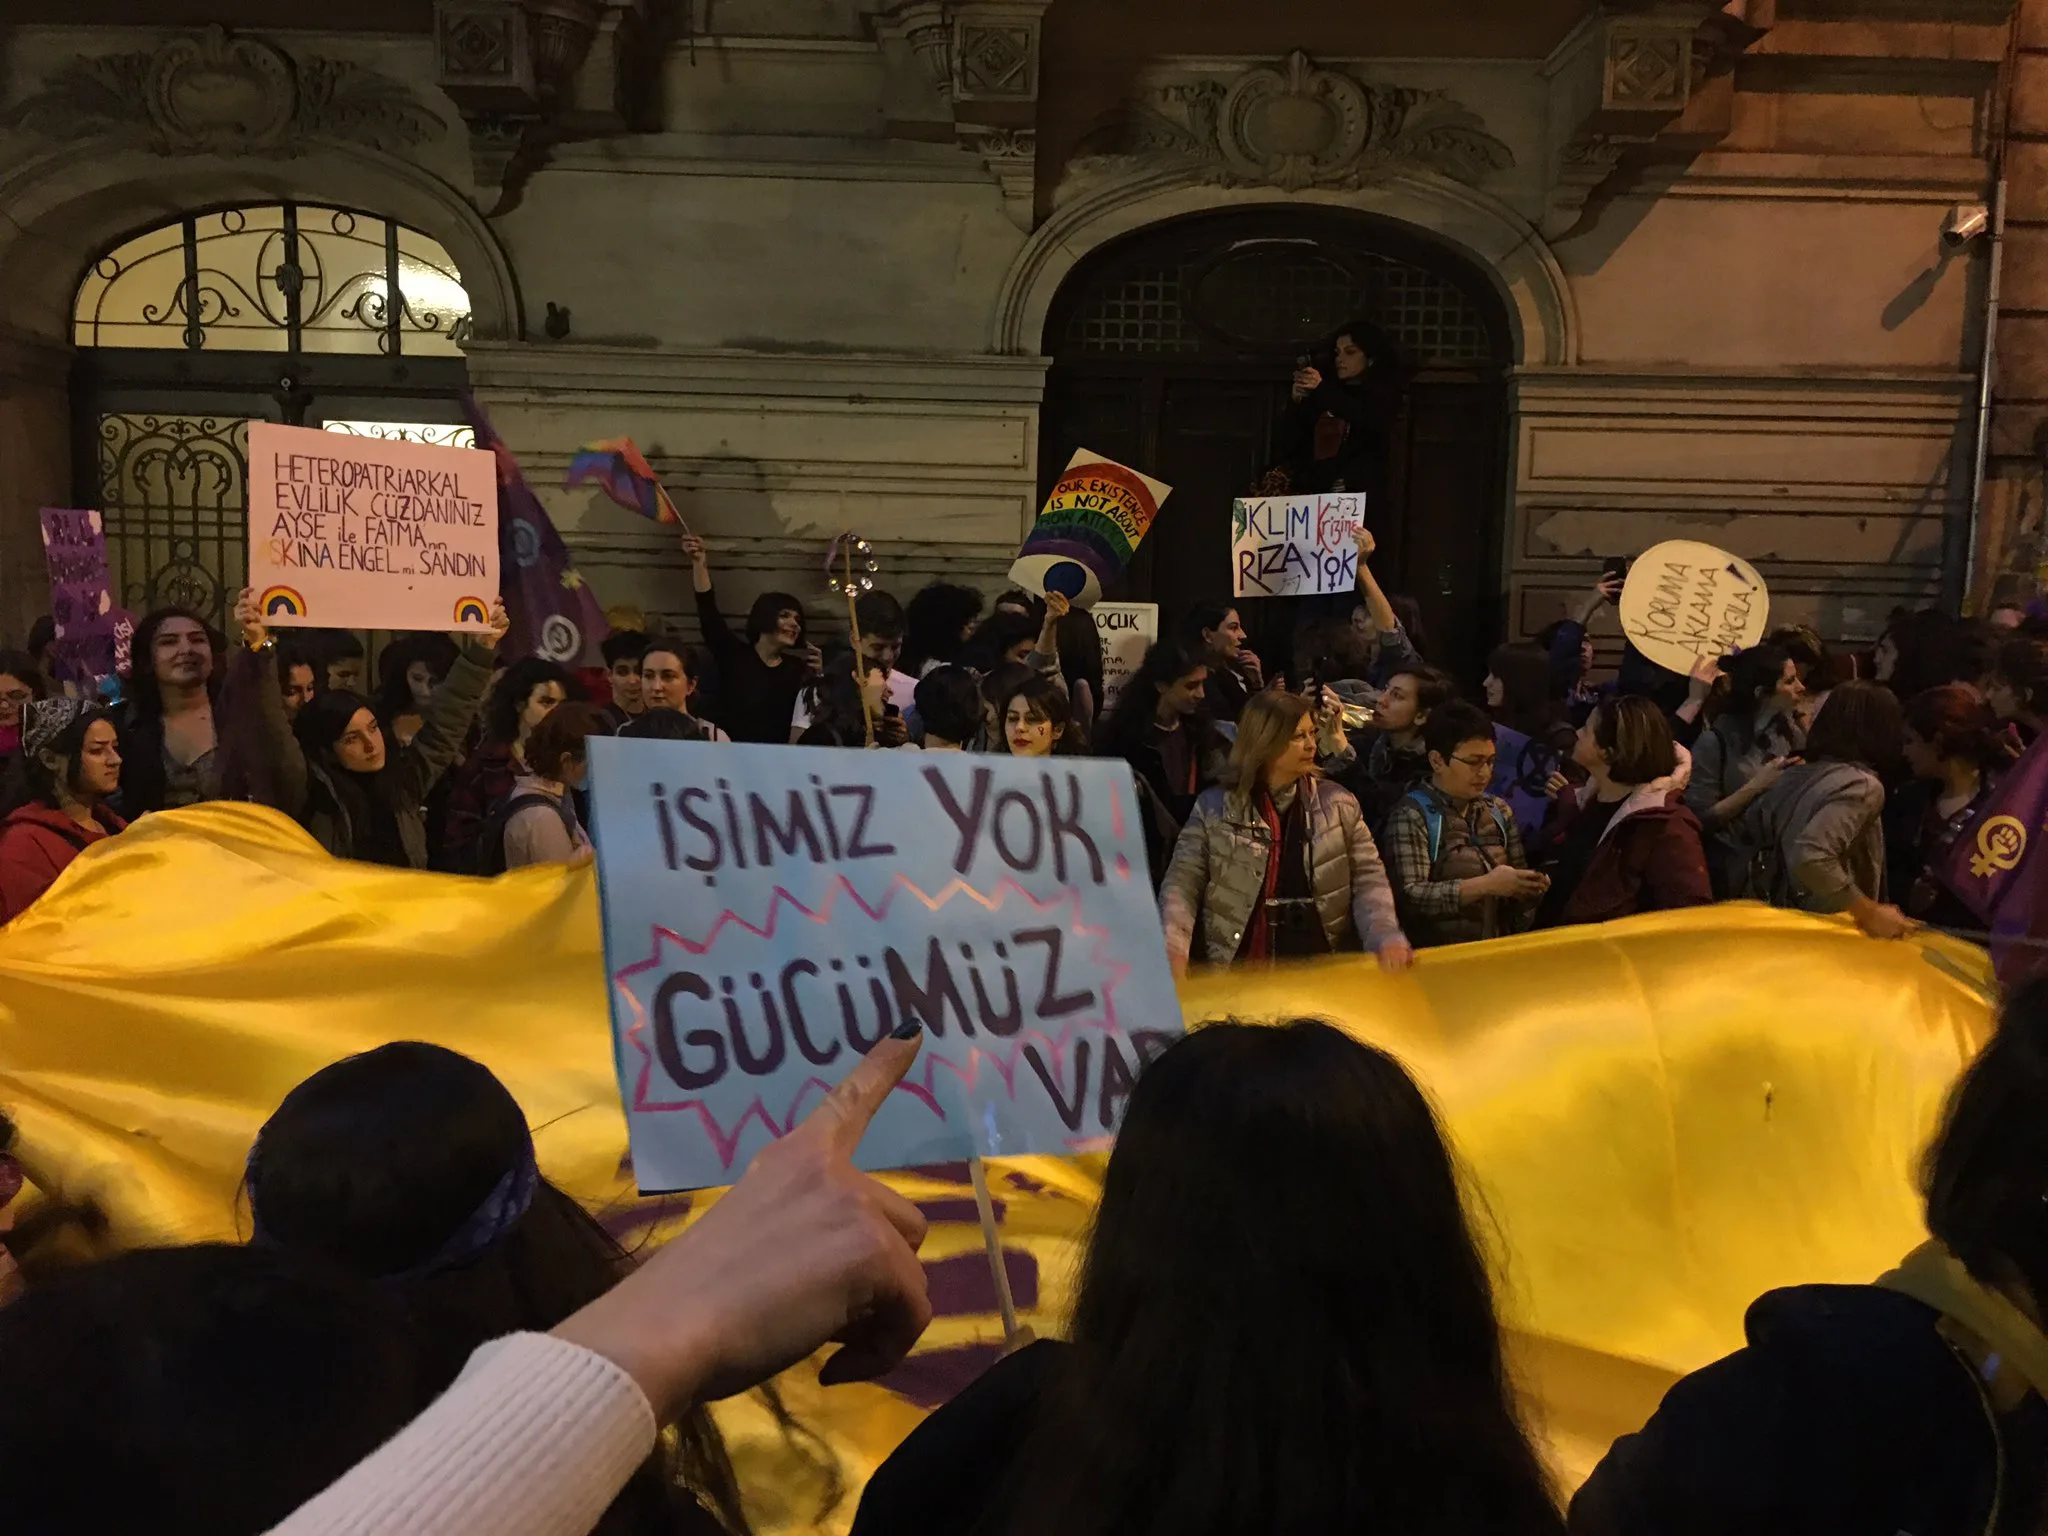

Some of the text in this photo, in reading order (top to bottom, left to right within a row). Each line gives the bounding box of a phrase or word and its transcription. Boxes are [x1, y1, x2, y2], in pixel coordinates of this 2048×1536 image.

[371, 492, 486, 527] CÜZDANINIZ
[1051, 493, 1140, 540] IS NOT ABOUT
[1057, 479, 1148, 528] OUR EXISTENCE
[339, 545, 400, 574] ENGEL
[419, 550, 486, 577] SANDIN
[1239, 542, 1358, 594] RIZA YOK
[1097, 613, 1140, 632] OCUK
[1628, 562, 1692, 646] KORUMA
[1676, 567, 1720, 656] AKLAMA
[650, 774, 897, 887] İŞİMİZ
[652, 926, 1095, 1091] GÜCÜMÜZ
